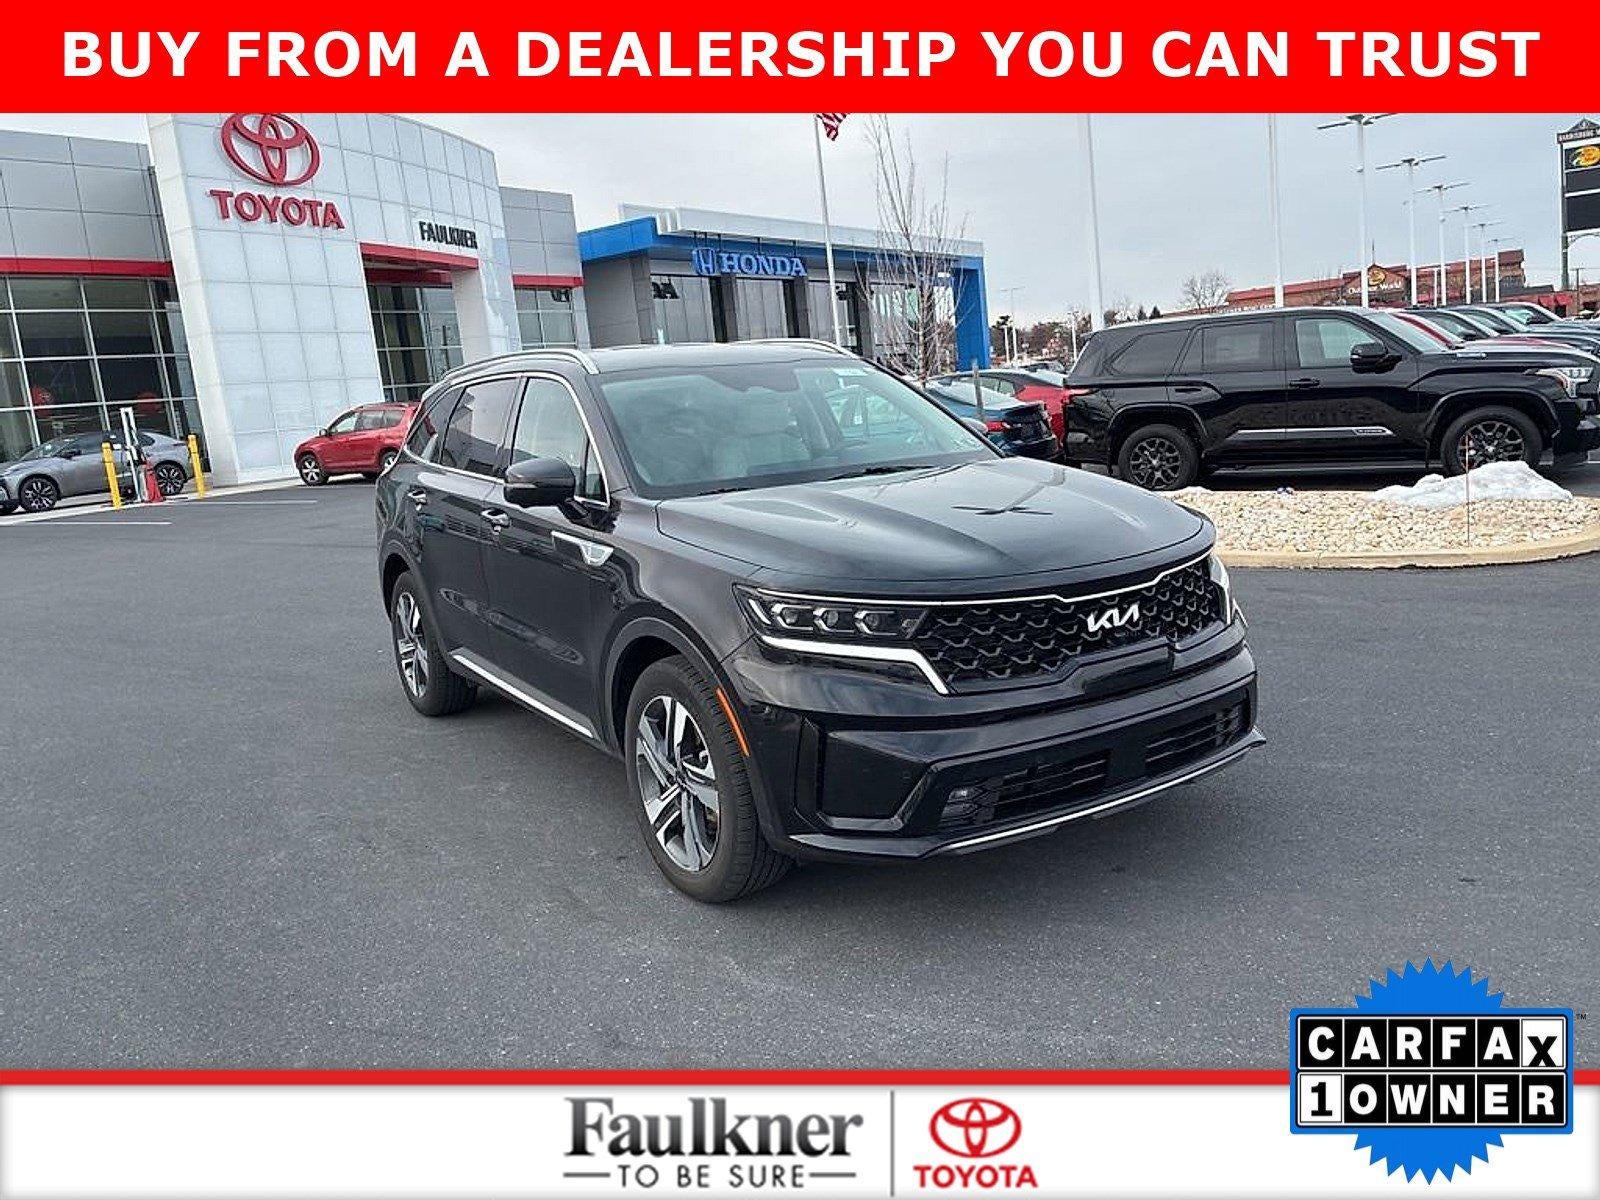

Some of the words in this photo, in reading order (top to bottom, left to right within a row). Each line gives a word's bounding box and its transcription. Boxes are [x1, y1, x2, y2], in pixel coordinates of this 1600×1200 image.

[209, 189, 345, 229] TOYOTA
[419, 221, 478, 249] FAULKNER
[719, 253, 807, 277] HONDA
